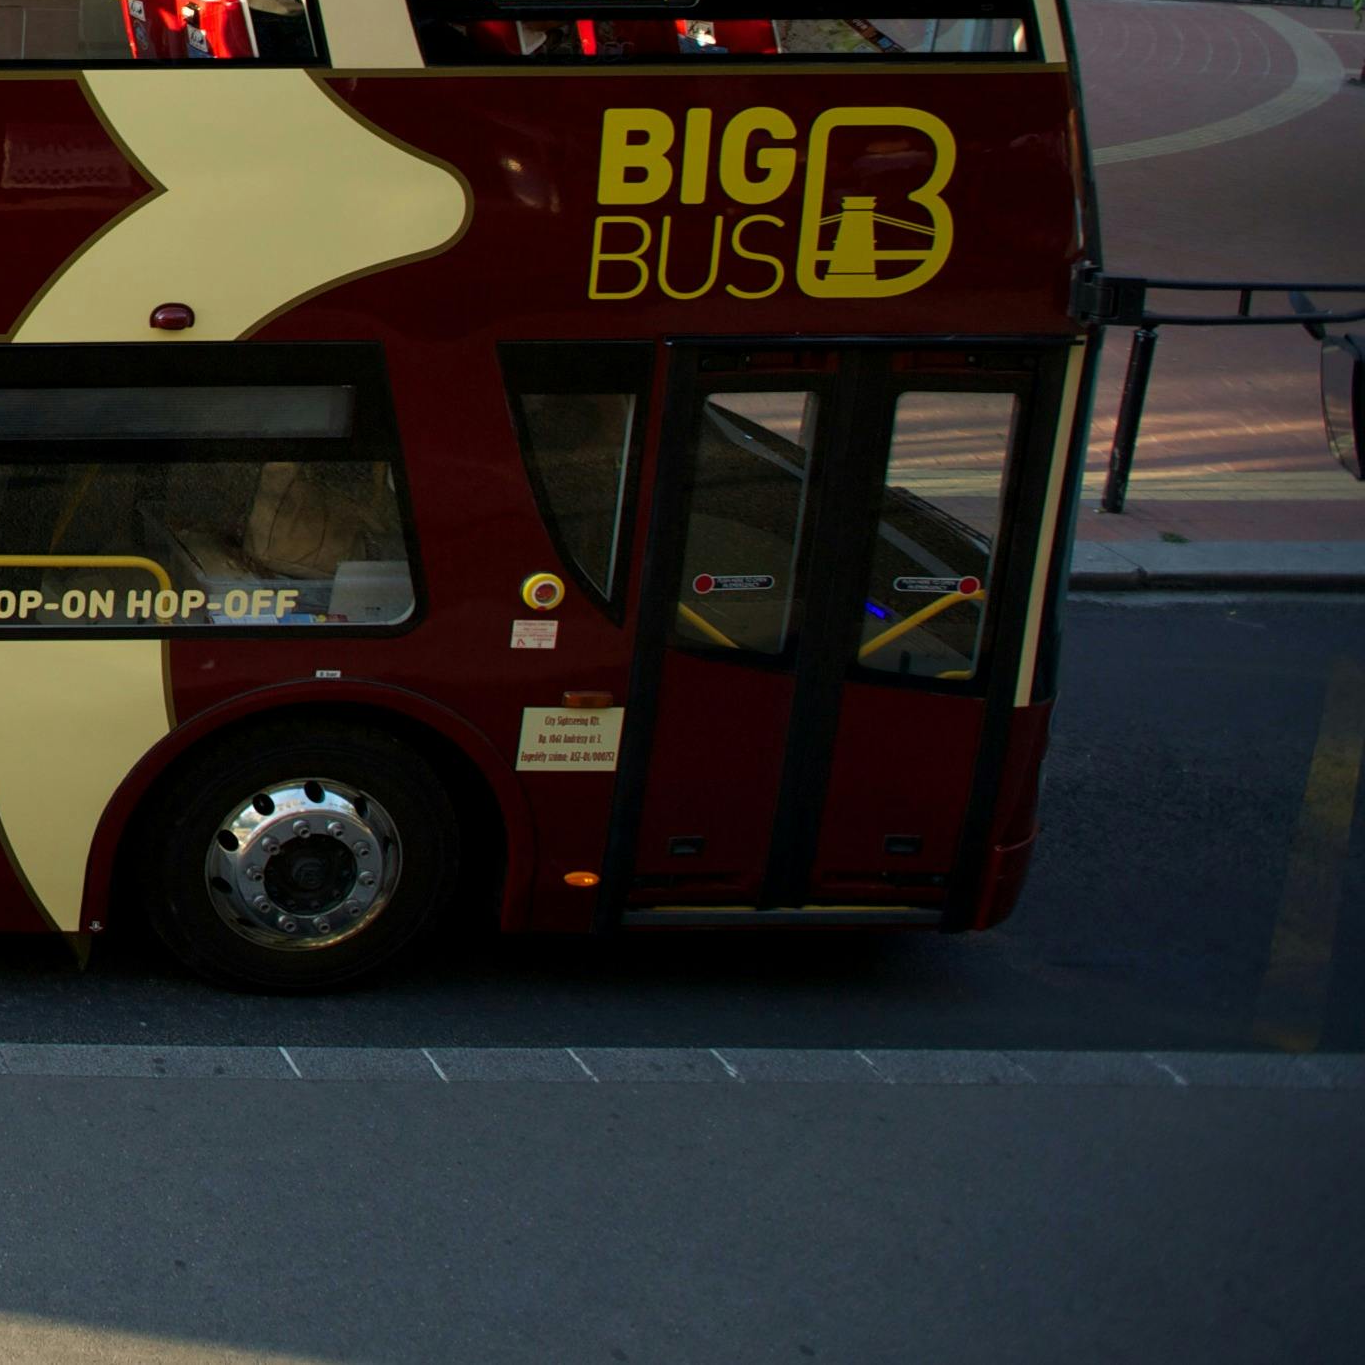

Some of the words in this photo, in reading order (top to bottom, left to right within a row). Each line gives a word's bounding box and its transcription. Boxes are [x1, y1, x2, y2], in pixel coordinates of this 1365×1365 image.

[597, 107, 797, 205] BIG
[588, 214, 785, 300] BUS
[126, 589, 300, 619] HOP-OFF
